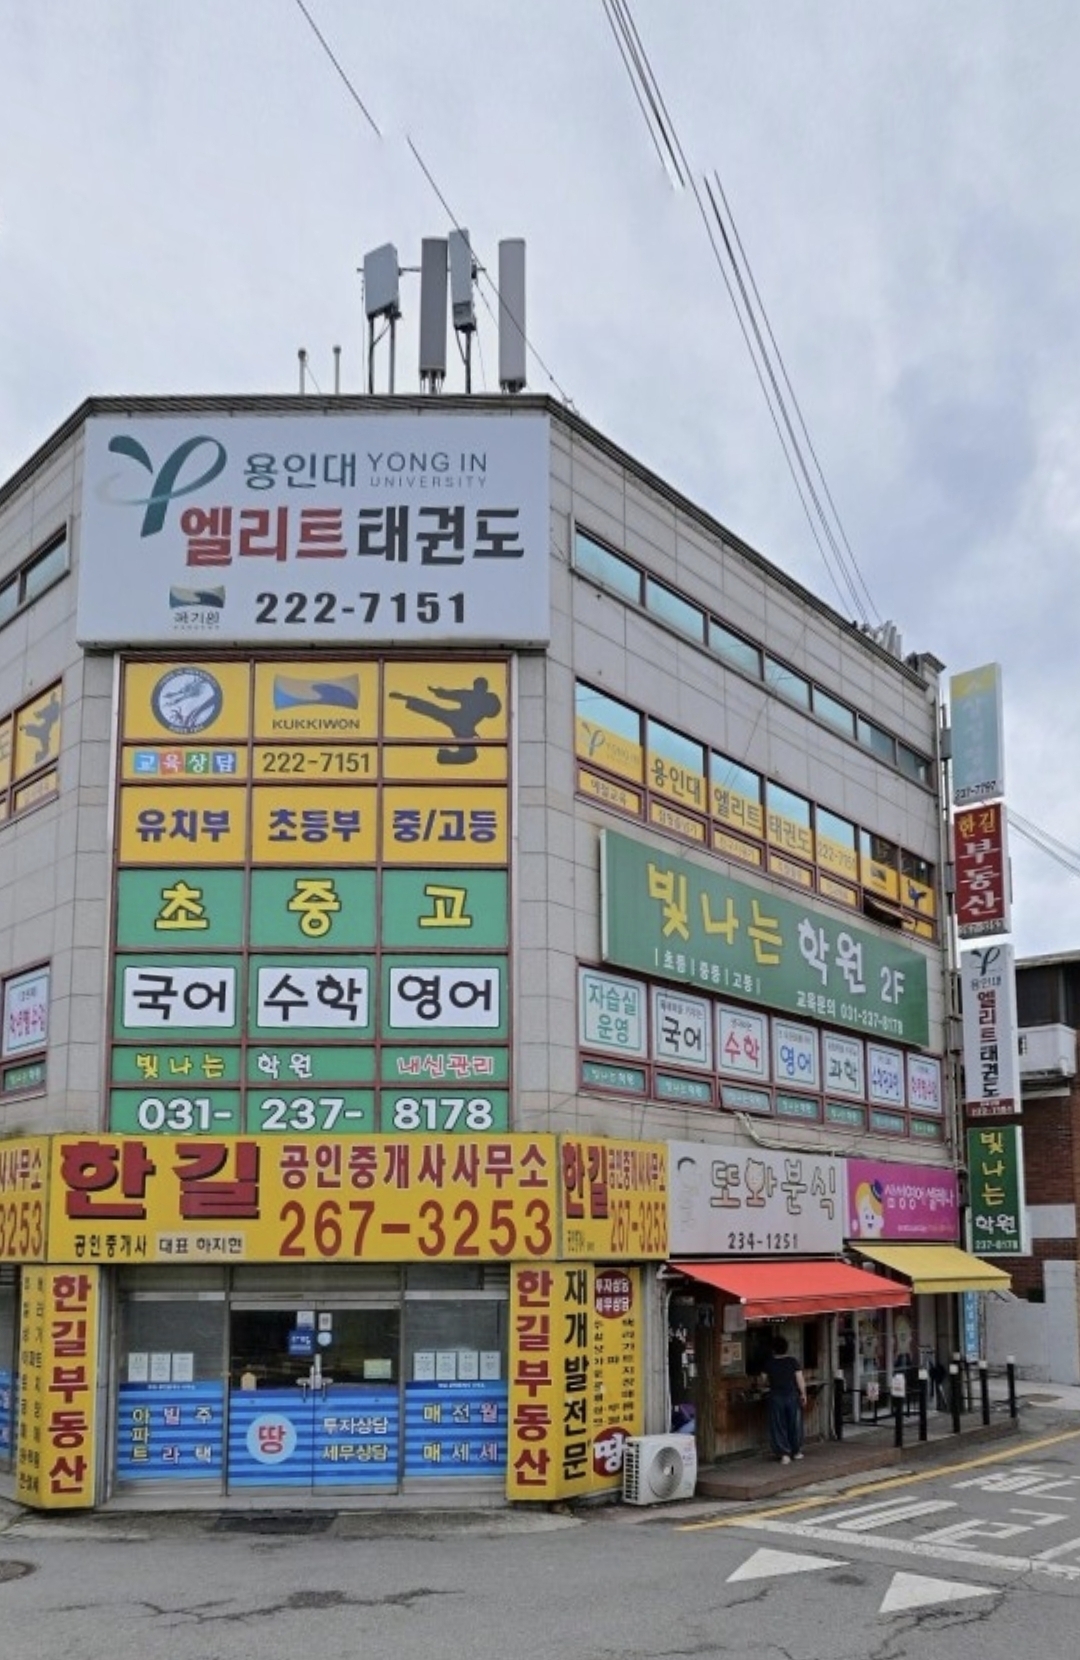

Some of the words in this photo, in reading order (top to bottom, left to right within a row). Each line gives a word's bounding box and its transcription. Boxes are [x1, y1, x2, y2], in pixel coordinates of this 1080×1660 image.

[245, 453, 356, 490] 용인대
[366, 453, 449, 473] YONG
[461, 453, 487, 473] IN
[369, 477, 487, 488] UNIVERSITY
[181, 506, 348, 567] 엘리트
[358, 506, 524, 566] 태권도
[255, 592, 466, 624] 222-7151
[272, 718, 360, 731] KUKKIWON
[136, 751, 235, 773] 교육상담
[262, 752, 370, 773] 222-7151
[652, 758, 700, 804] 용인대
[136, 809, 231, 843] 유치부
[268, 808, 361, 842] 초등부
[392, 809, 498, 843] 중/고등
[714, 787, 762, 832] 엘리트
[958, 808, 996, 839] 한길
[769, 814, 812, 853] 태권도
[959, 838, 1001, 916] 부동산
[154, 880, 210, 930] 초
[287, 878, 341, 937] 중
[418, 884, 472, 927] 고
[646, 862, 784, 966] 빛나는
[798, 917, 866, 994] 학원
[880, 966, 905, 1005] 2F
[133, 973, 227, 1020] 국어
[263, 973, 362, 1021] 수학
[397, 974, 492, 1020] 영어
[587, 983, 637, 1016] 자습실
[971, 976, 1001, 991] 용인대
[796, 991, 836, 1019] 교육문의
[977, 990, 997, 1043] 엘리트
[598, 1014, 628, 1044] 운영
[661, 1016, 700, 1052] 국어
[136, 1053, 225, 1079] 빛나는
[257, 1052, 313, 1079] 학원
[397, 1053, 494, 1078] 내신관리
[724, 1031, 760, 1069] 수학
[780, 1045, 812, 1076] 영어
[829, 1057, 857, 1089] 과학
[138, 1098, 233, 1131] 031-
[260, 1098, 363, 1132] 237-
[393, 1098, 493, 1131] 8178
[61, 1141, 260, 1220] 한길
[562, 1142, 608, 1219] 한길
[981, 1132, 1005, 1206] 빛나는
[279, 1199, 553, 1258] 267-3253
[610, 1199, 668, 1254] 267-3253
[975, 1213, 1018, 1235] 학원
[74, 1234, 148, 1258] 공인중개사
[159, 1236, 190, 1254] 대표
[728, 1232, 799, 1251] 234-1251
[48, 1275, 92, 1494] 한길부동산
[514, 1270, 554, 1486] 한길부동산
[562, 1269, 590, 1481] 재개발전문
[131, 1407, 150, 1463] 아파트
[258, 1425, 286, 1456] 땅
[323, 1416, 388, 1435] 투자상담
[322, 1443, 388, 1463] 세무상담
